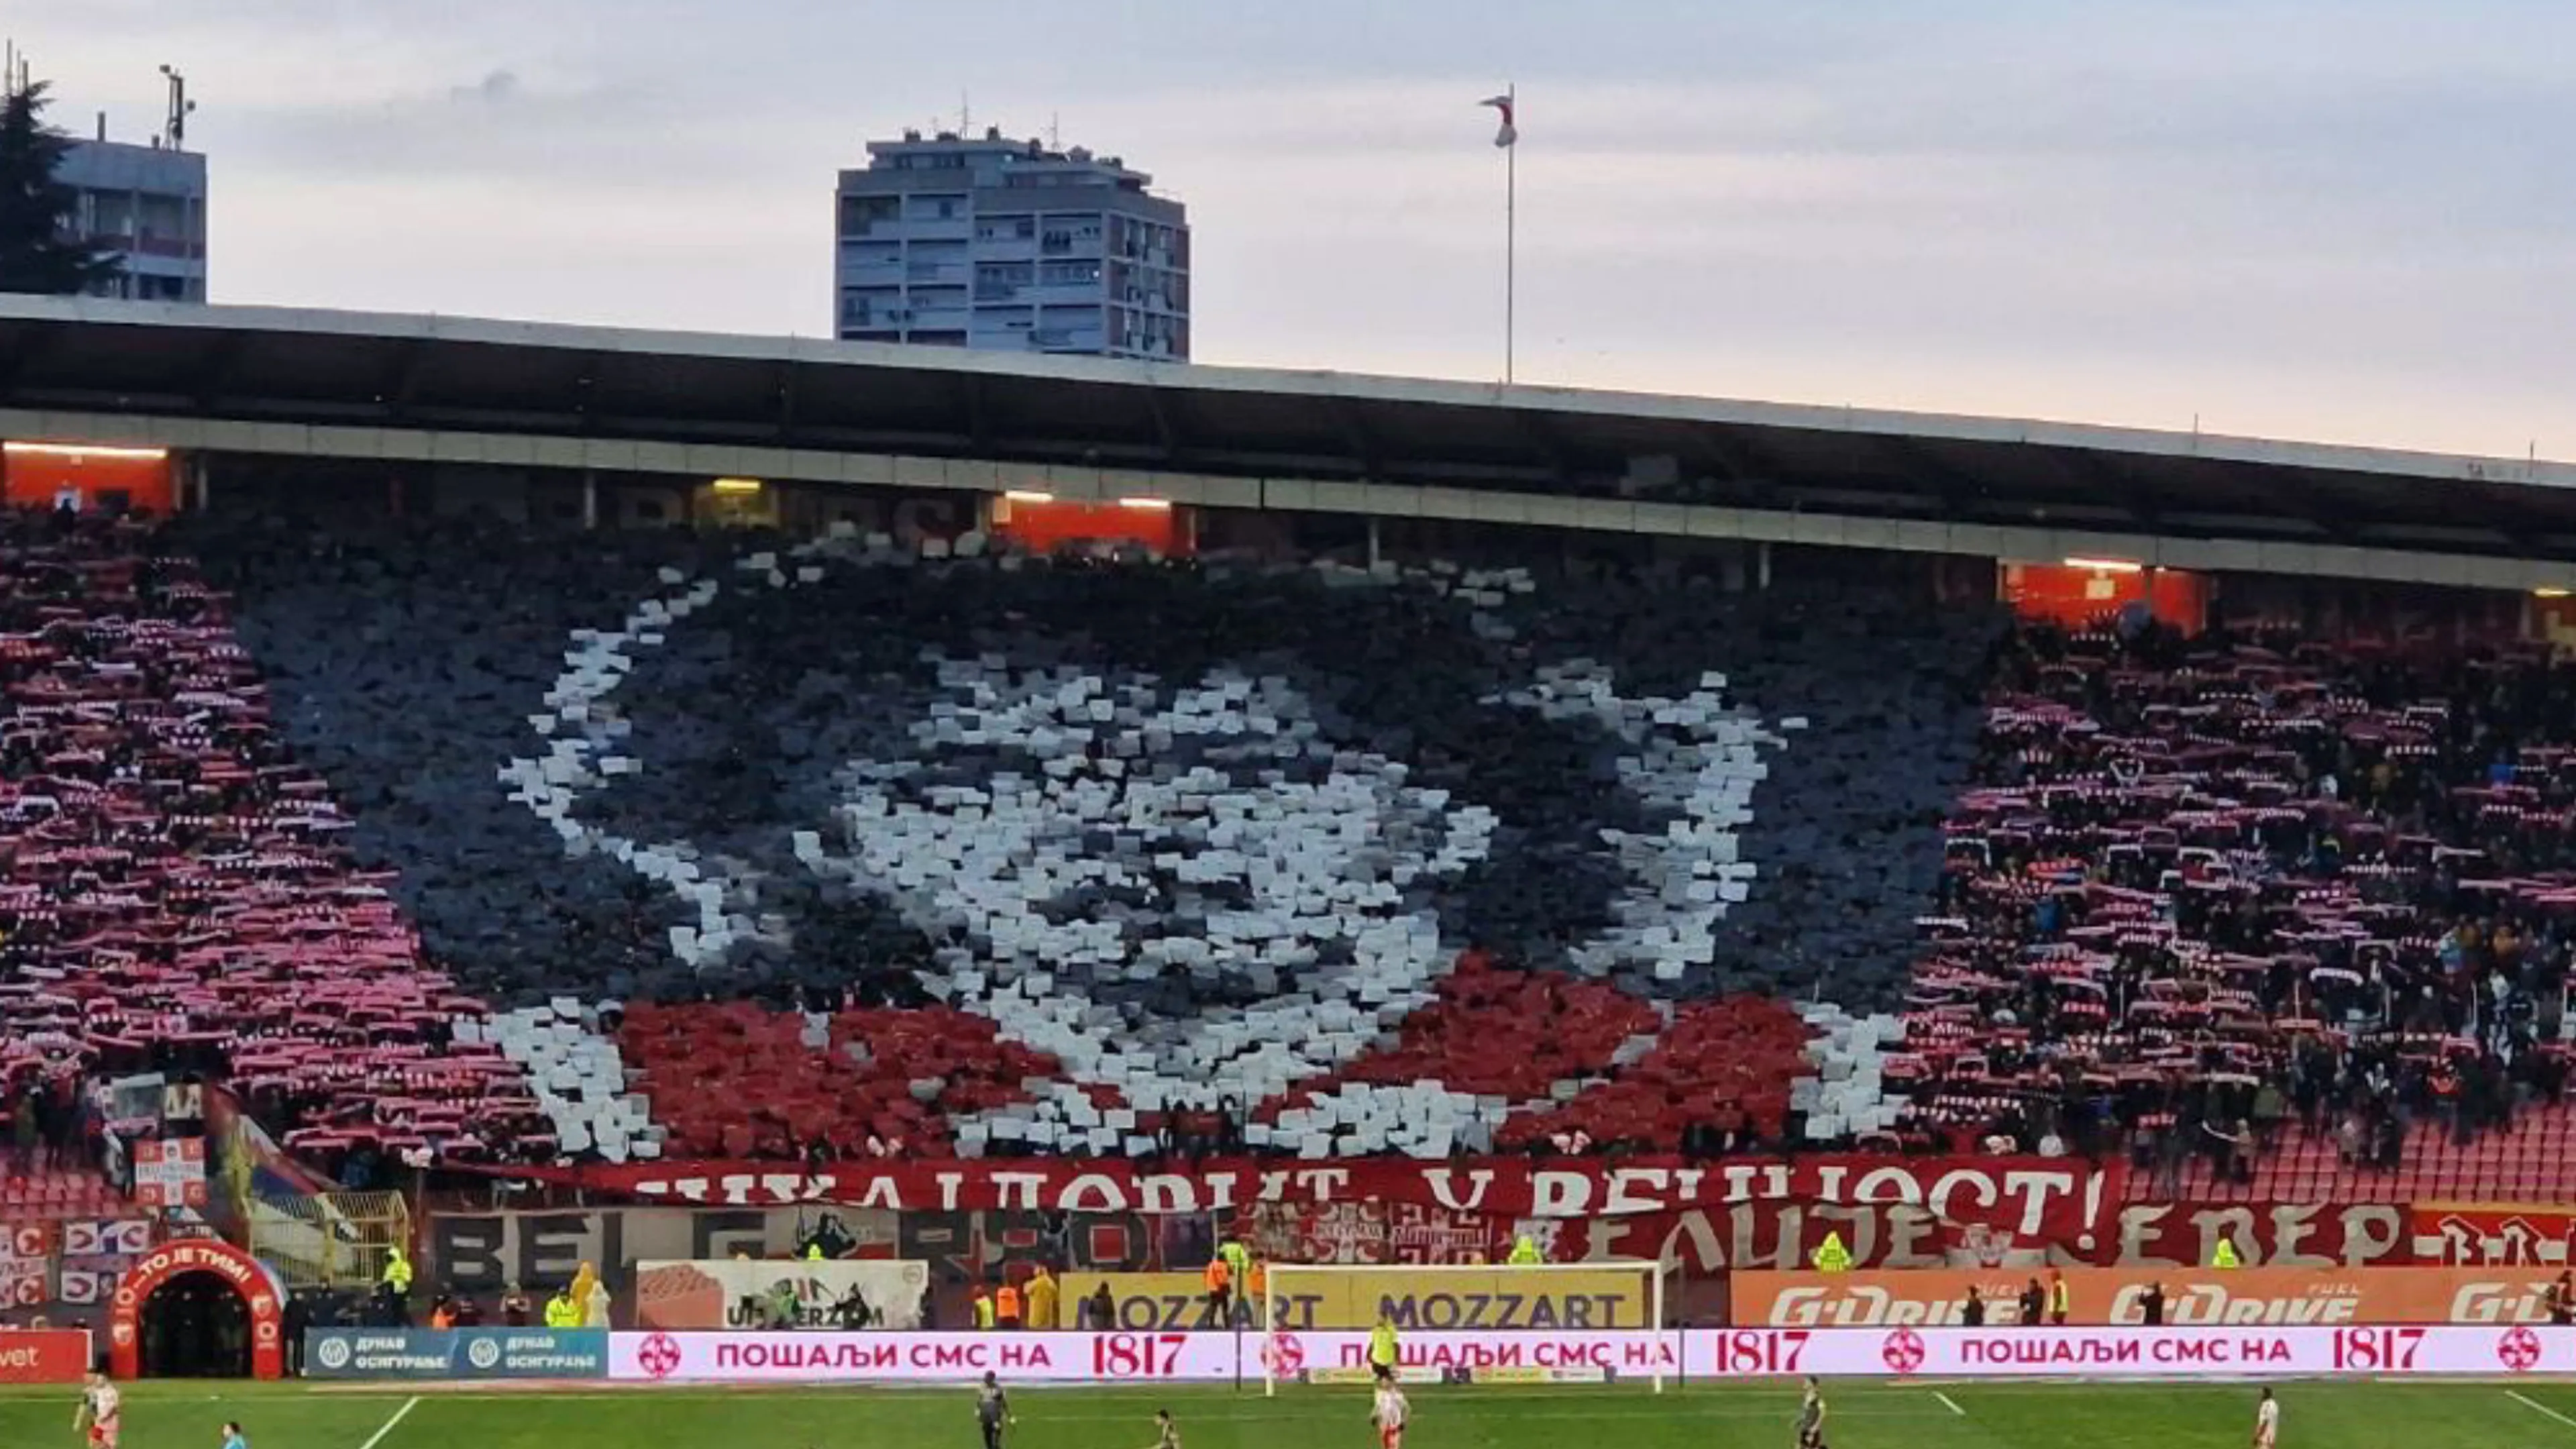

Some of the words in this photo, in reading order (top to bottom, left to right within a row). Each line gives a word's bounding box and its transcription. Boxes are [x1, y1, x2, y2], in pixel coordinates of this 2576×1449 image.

[1379, 1293, 1625, 1328] MOZZART
[716, 1344, 898, 1367] ПОШАЉИ
[910, 1344, 987, 1367] СМС
[1000, 1344, 1051, 1367] НА
[1092, 1334, 1187, 1375] 1817
[1340, 1342, 1520, 1367] ПШАЉИ
[1625, 1342, 1676, 1366] НА
[1716, 1332, 1811, 1372] 1817
[1961, 1340, 2139, 1362] ПОШАЉИ
[2152, 1340, 2229, 1362] СМС
[2241, 1340, 2292, 1362] НА
[2332, 1329, 2426, 1369] 1817
